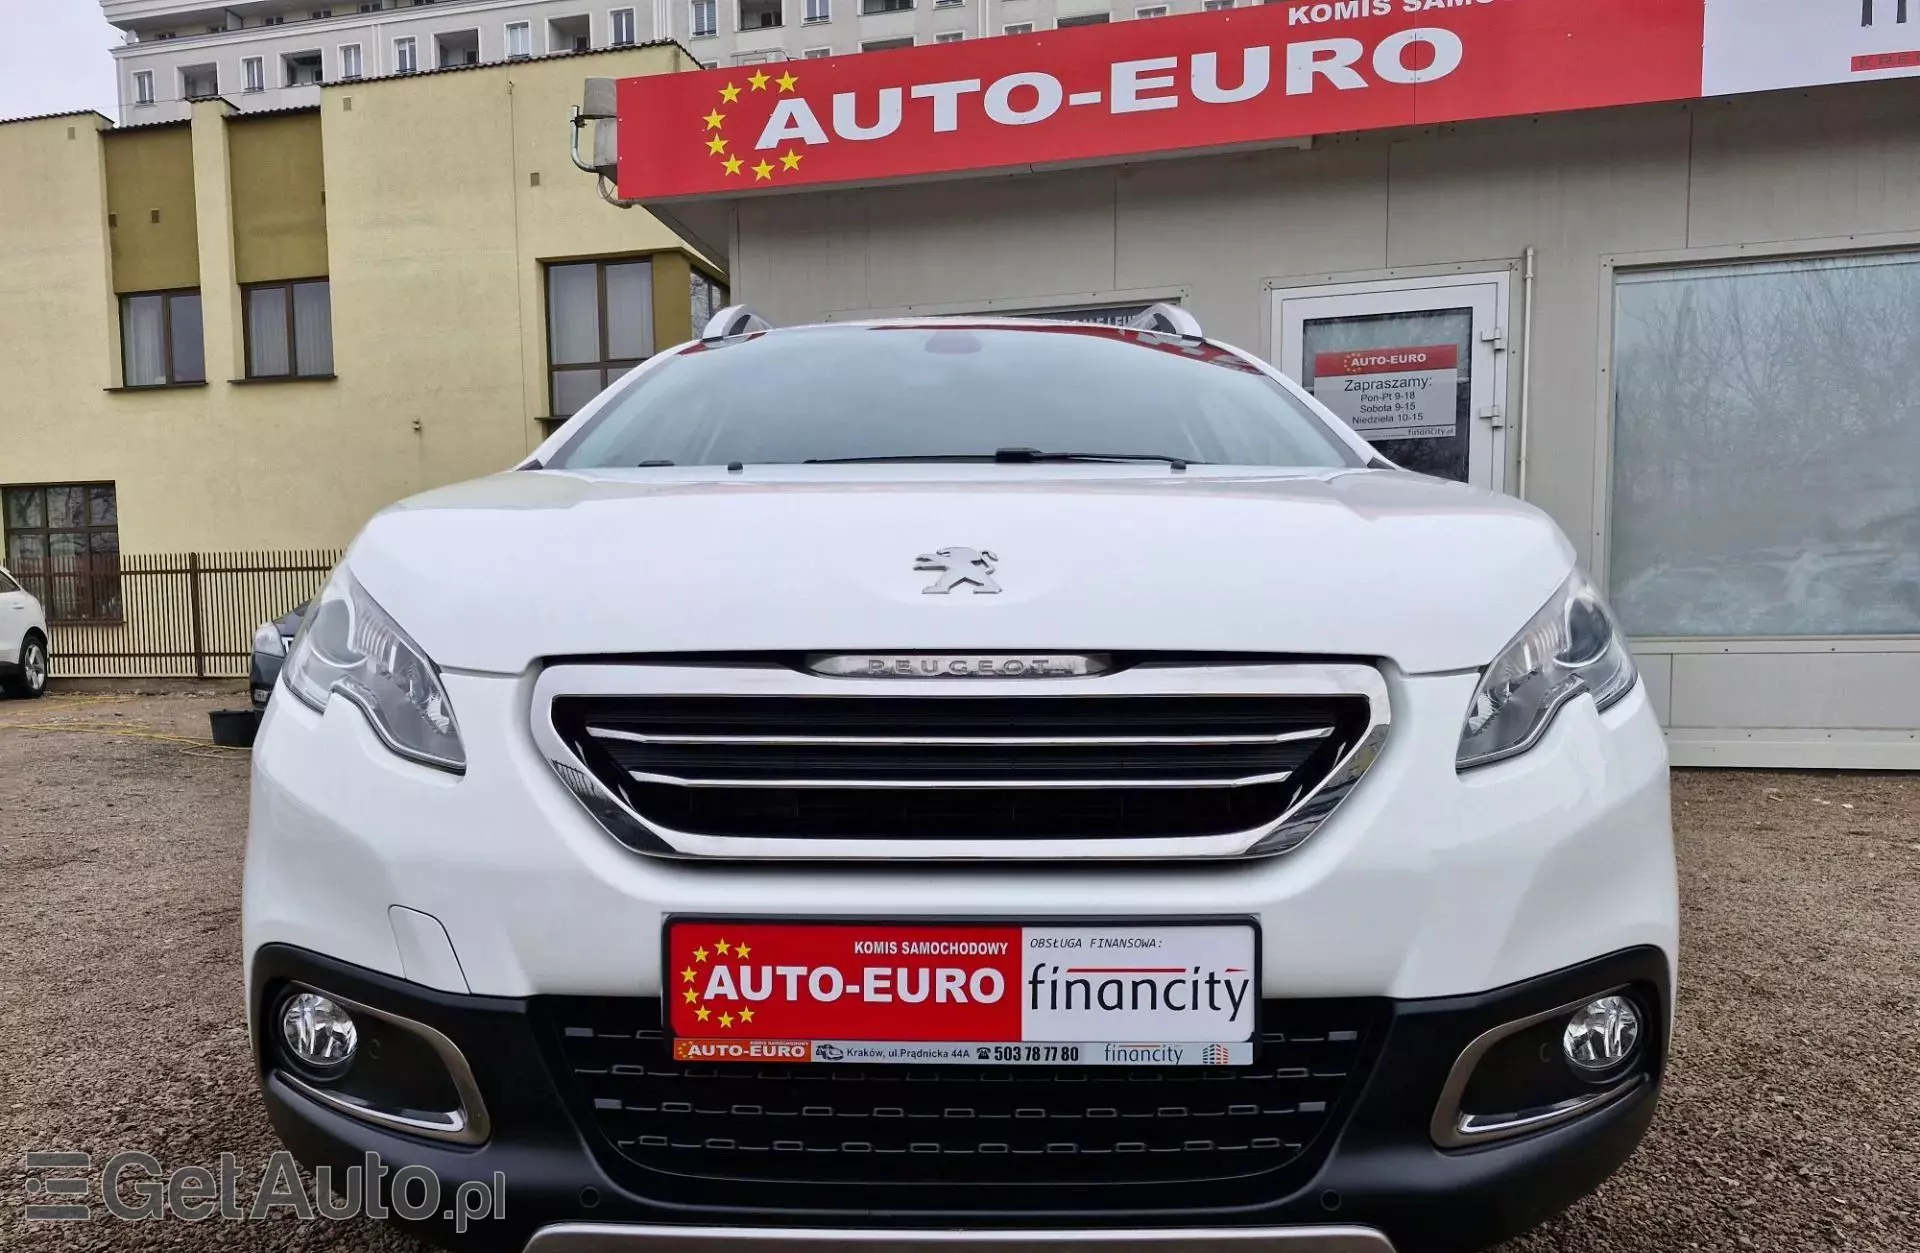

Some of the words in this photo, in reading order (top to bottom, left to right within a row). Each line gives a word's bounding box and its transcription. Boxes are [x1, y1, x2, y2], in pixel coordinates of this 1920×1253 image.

[1288, 0, 1392, 26] KOMIS
[754, 27, 1463, 150] AUTO-EURO
[1351, 353, 1427, 367] AUTO-EURO
[1344, 376, 1432, 393] Zapraszamy:
[1360, 393, 1392, 402] Pon-Pt
[1394, 391, 1416, 401] 9-18
[1360, 404, 1392, 414] Sobota
[1394, 402, 1416, 411] 9-15
[1352, 415, 1394, 425] Niedziela
[1398, 412, 1424, 422] 10-15
[868, 659, 1050, 676] PEUGEOT
[854, 941, 898, 954] KOMIS
[902, 942, 1008, 955] SAMOCHODOWY
[1030, 938, 1082, 948] OBSŁUGA
[1090, 938, 1163, 949] FINANSOWA:
[703, 965, 1005, 1004] AUTO-EURO
[1028, 962, 1249, 1022] financity
[687, 1044, 805, 1057] AUTO-EURO
[846, 1048, 886, 1058] Kraków,
[951, 1050, 970, 1058] 44A
[994, 1046, 1021, 1061] 503
[1025, 1047, 1041, 1061] 78
[1044, 1047, 1058, 1061] 77
[1060, 1047, 1079, 1061] 80
[1104, 1044, 1183, 1064] financity
